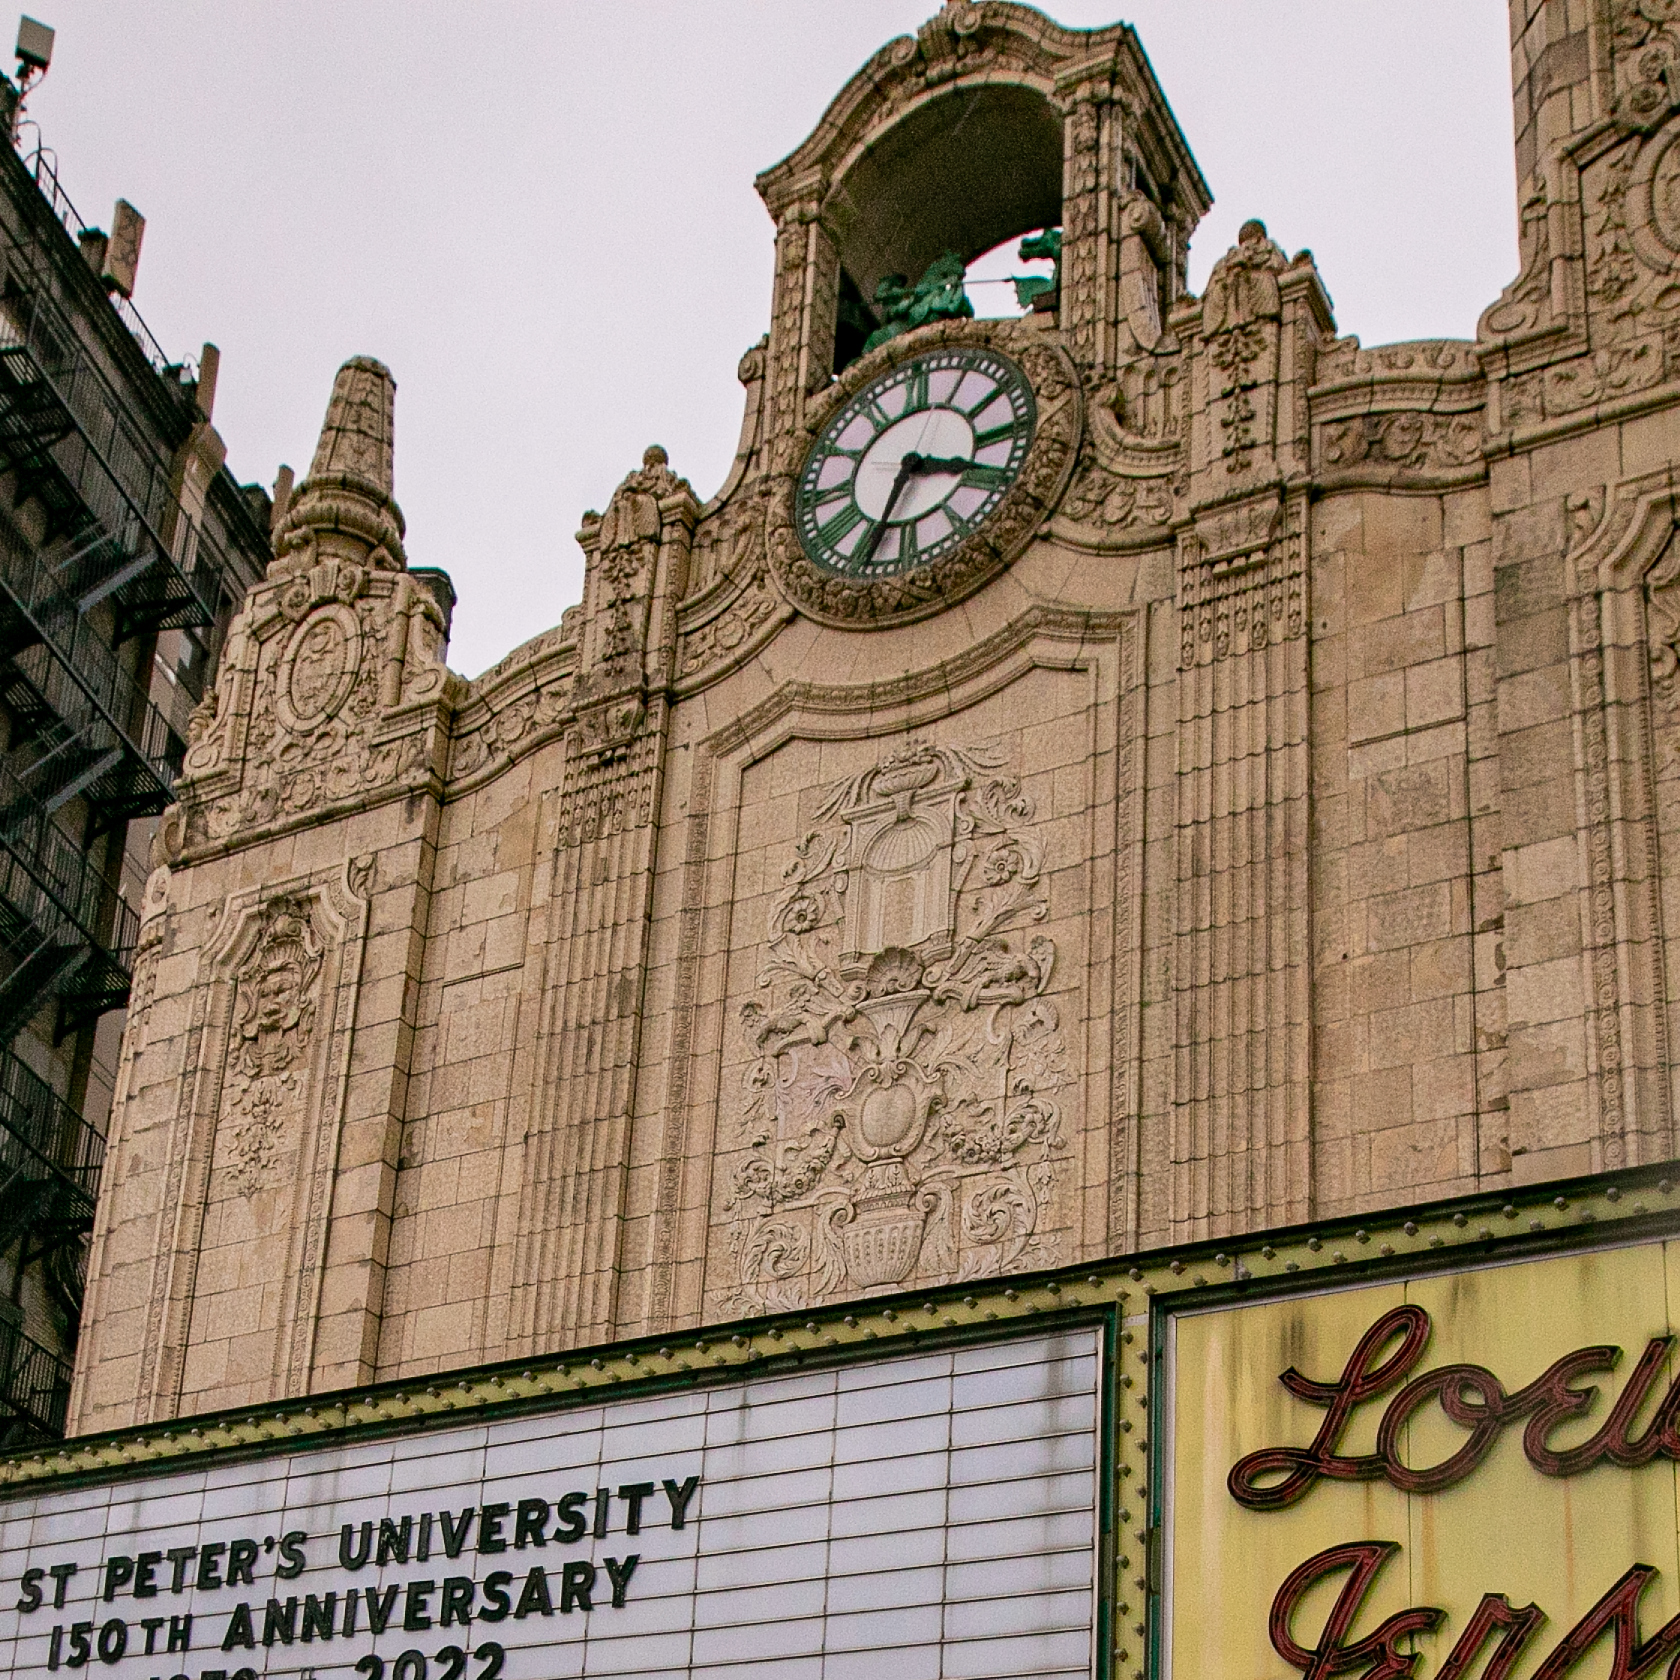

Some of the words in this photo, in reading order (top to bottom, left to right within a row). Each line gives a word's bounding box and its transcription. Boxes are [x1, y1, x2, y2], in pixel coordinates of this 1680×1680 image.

[16, 1562, 77, 1613] ST
[102, 1530, 308, 1602] PETER'S
[338, 1475, 700, 1572] UNIVERSITY
[47, 1613, 193, 1671] 150TH
[221, 1554, 640, 1652] ANNIVERSARY
